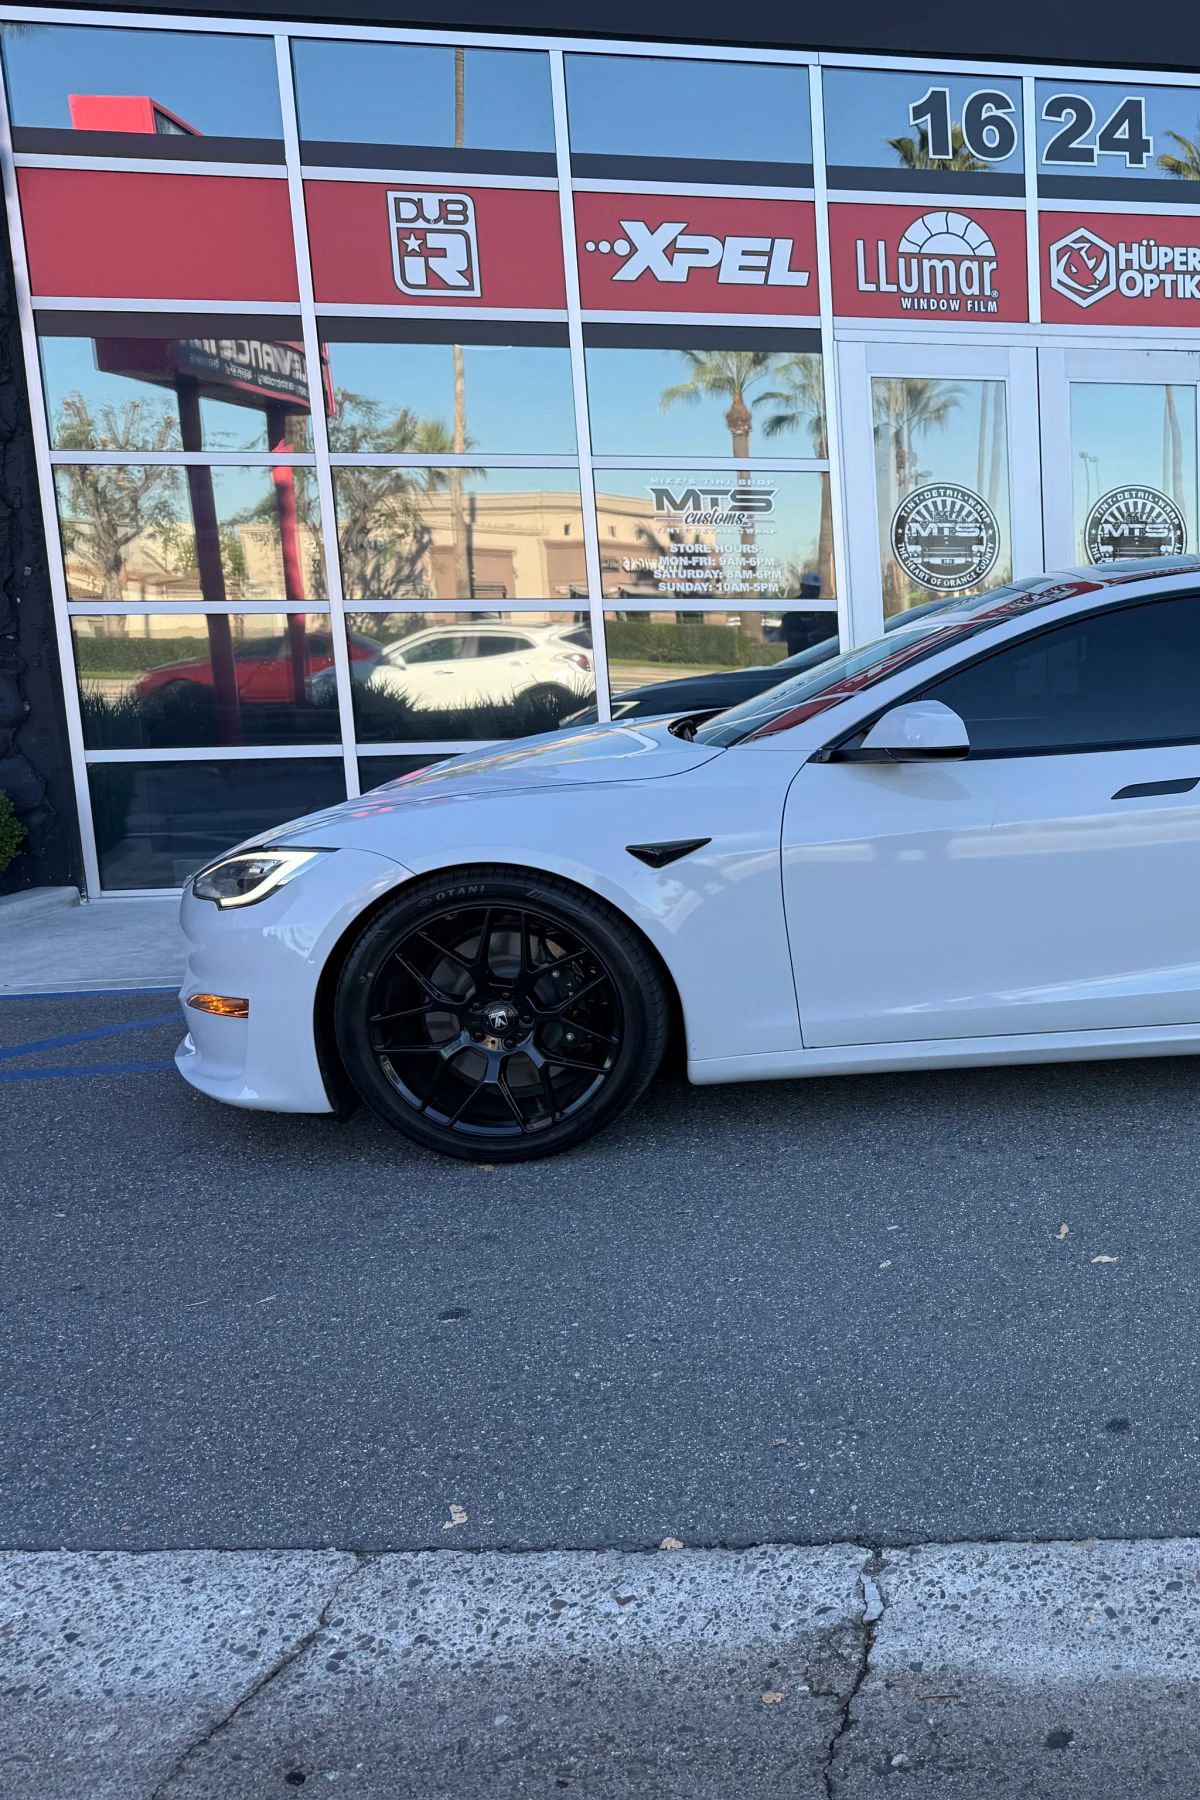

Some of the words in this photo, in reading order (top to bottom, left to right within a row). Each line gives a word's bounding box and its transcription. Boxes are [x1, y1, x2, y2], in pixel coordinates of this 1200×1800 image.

[394, 197, 469, 225] DUB
[611, 220, 811, 287] XPEL
[900, 297, 961, 312] WINDOW
[967, 298, 998, 313] FILM
[650, 477, 697, 486] MIKE'S
[703, 478, 732, 486] TINT
[738, 478, 776, 487] SHOP
[648, 487, 779, 514] MTS
[900, 497, 923, 518] TINT
[924, 489, 966, 500] DETAIL
[967, 497, 991, 524] WRAP
[1094, 499, 1114, 519] TINT
[1117, 490, 1154, 502] DETAIL
[1157, 499, 1180, 525] WRAP
[684, 507, 746, 525] customs
[909, 522, 981, 537] MTS
[1101, 523, 1171, 537] MTS
[670, 543, 711, 554] STORE
[659, 556, 716, 566] MON-FRI:
[719, 556, 775, 566] 9AM-6PM
[897, 542, 906, 560] THE
[904, 559, 930, 583] HEART
[930, 577, 942, 586] OF
[943, 570, 977, 587] ORANGE
[975, 542, 995, 574] COUNTY
[654, 569, 723, 579] SATURDAY:
[727, 569, 782, 579] 8AM-6PM
[658, 582, 713, 592] SUNDAY:
[717, 582, 779, 592] 10AM-5PM
[436, 885, 485, 900] OTANI
